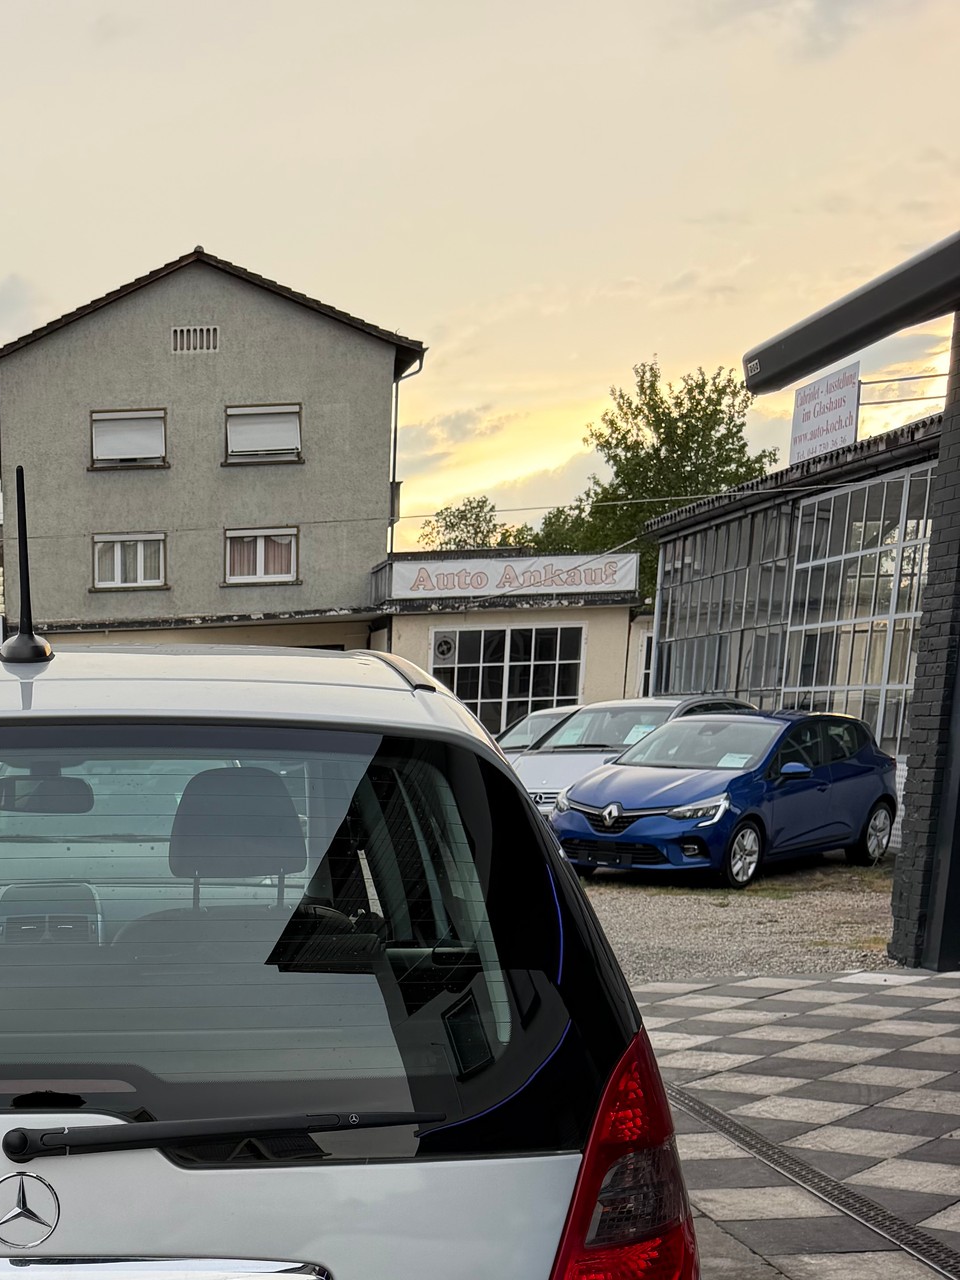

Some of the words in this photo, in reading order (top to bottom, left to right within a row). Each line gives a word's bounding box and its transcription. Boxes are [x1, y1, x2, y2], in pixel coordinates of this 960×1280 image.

[802, 408, 811, 423] im
[813, 396, 846, 418] Glashaus
[793, 411, 853, 445] www.auto-koch.ch
[410, 567, 489, 591] Auto
[496, 561, 618, 589] Ankauf
